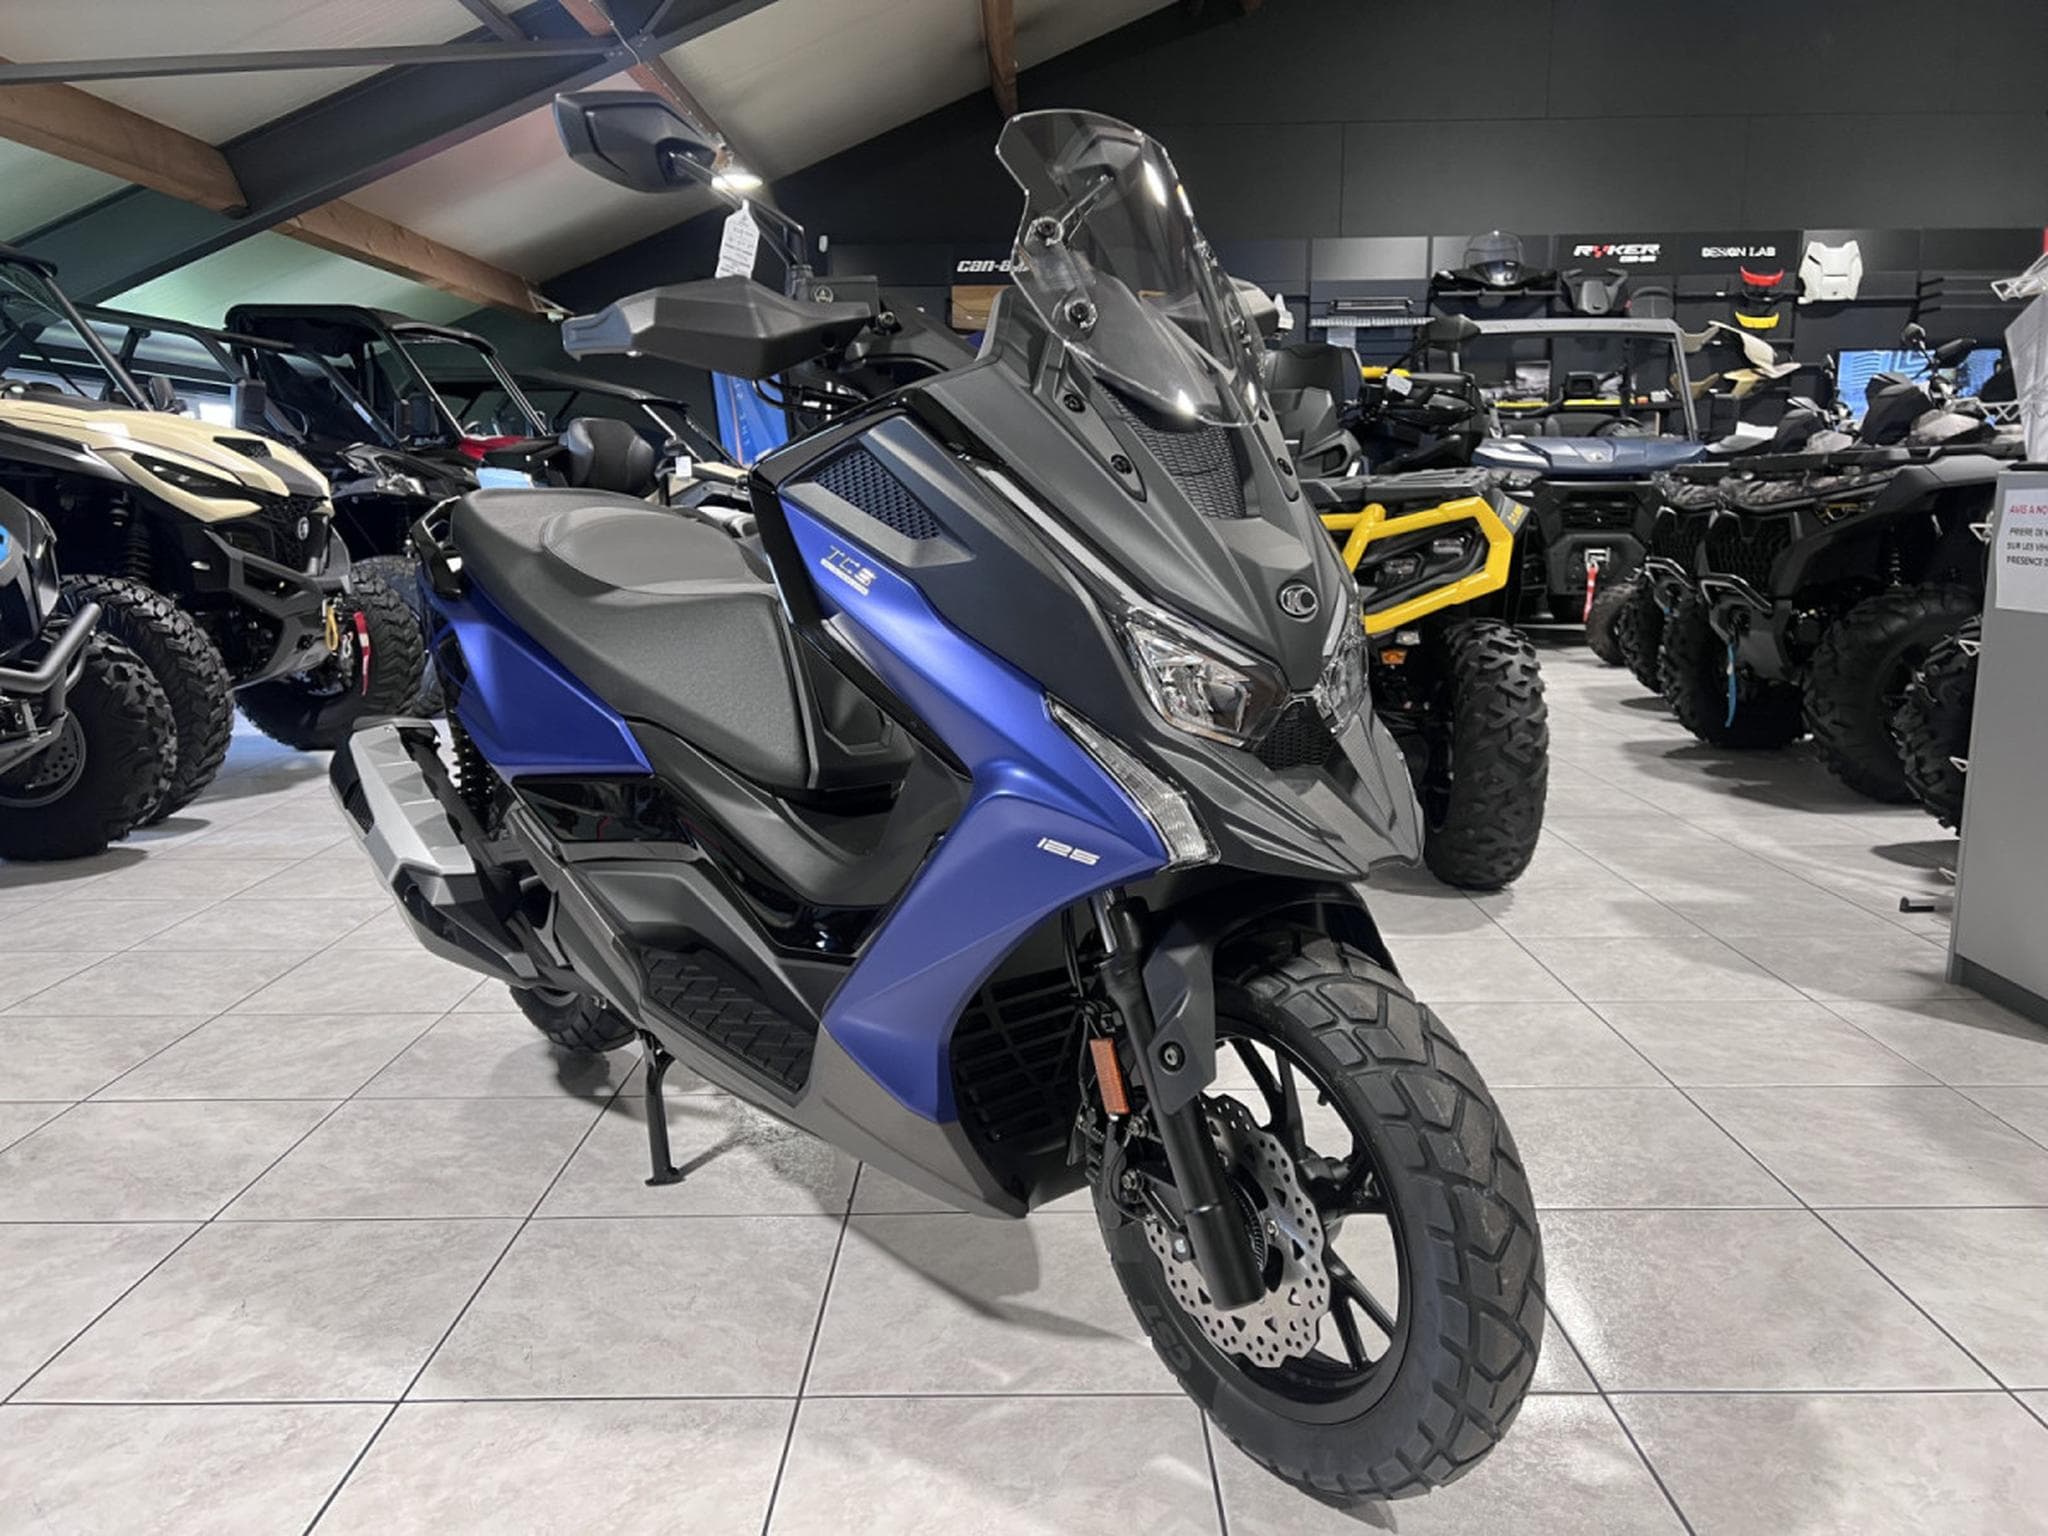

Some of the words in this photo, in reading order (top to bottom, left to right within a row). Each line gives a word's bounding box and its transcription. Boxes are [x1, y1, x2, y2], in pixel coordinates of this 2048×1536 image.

[1573, 243, 1660, 258] RYKER
[1701, 246, 1746, 258] DESIGN
[1749, 246, 1776, 257] LAB
[2008, 504, 2027, 515] AVIS
[2009, 527, 2033, 537] PRIERE
[2006, 542, 2020, 551] SUR
[2022, 542, 2034, 552] LES
[2006, 555, 2042, 567] PRESENCE
[1037, 837, 1101, 866] 125
